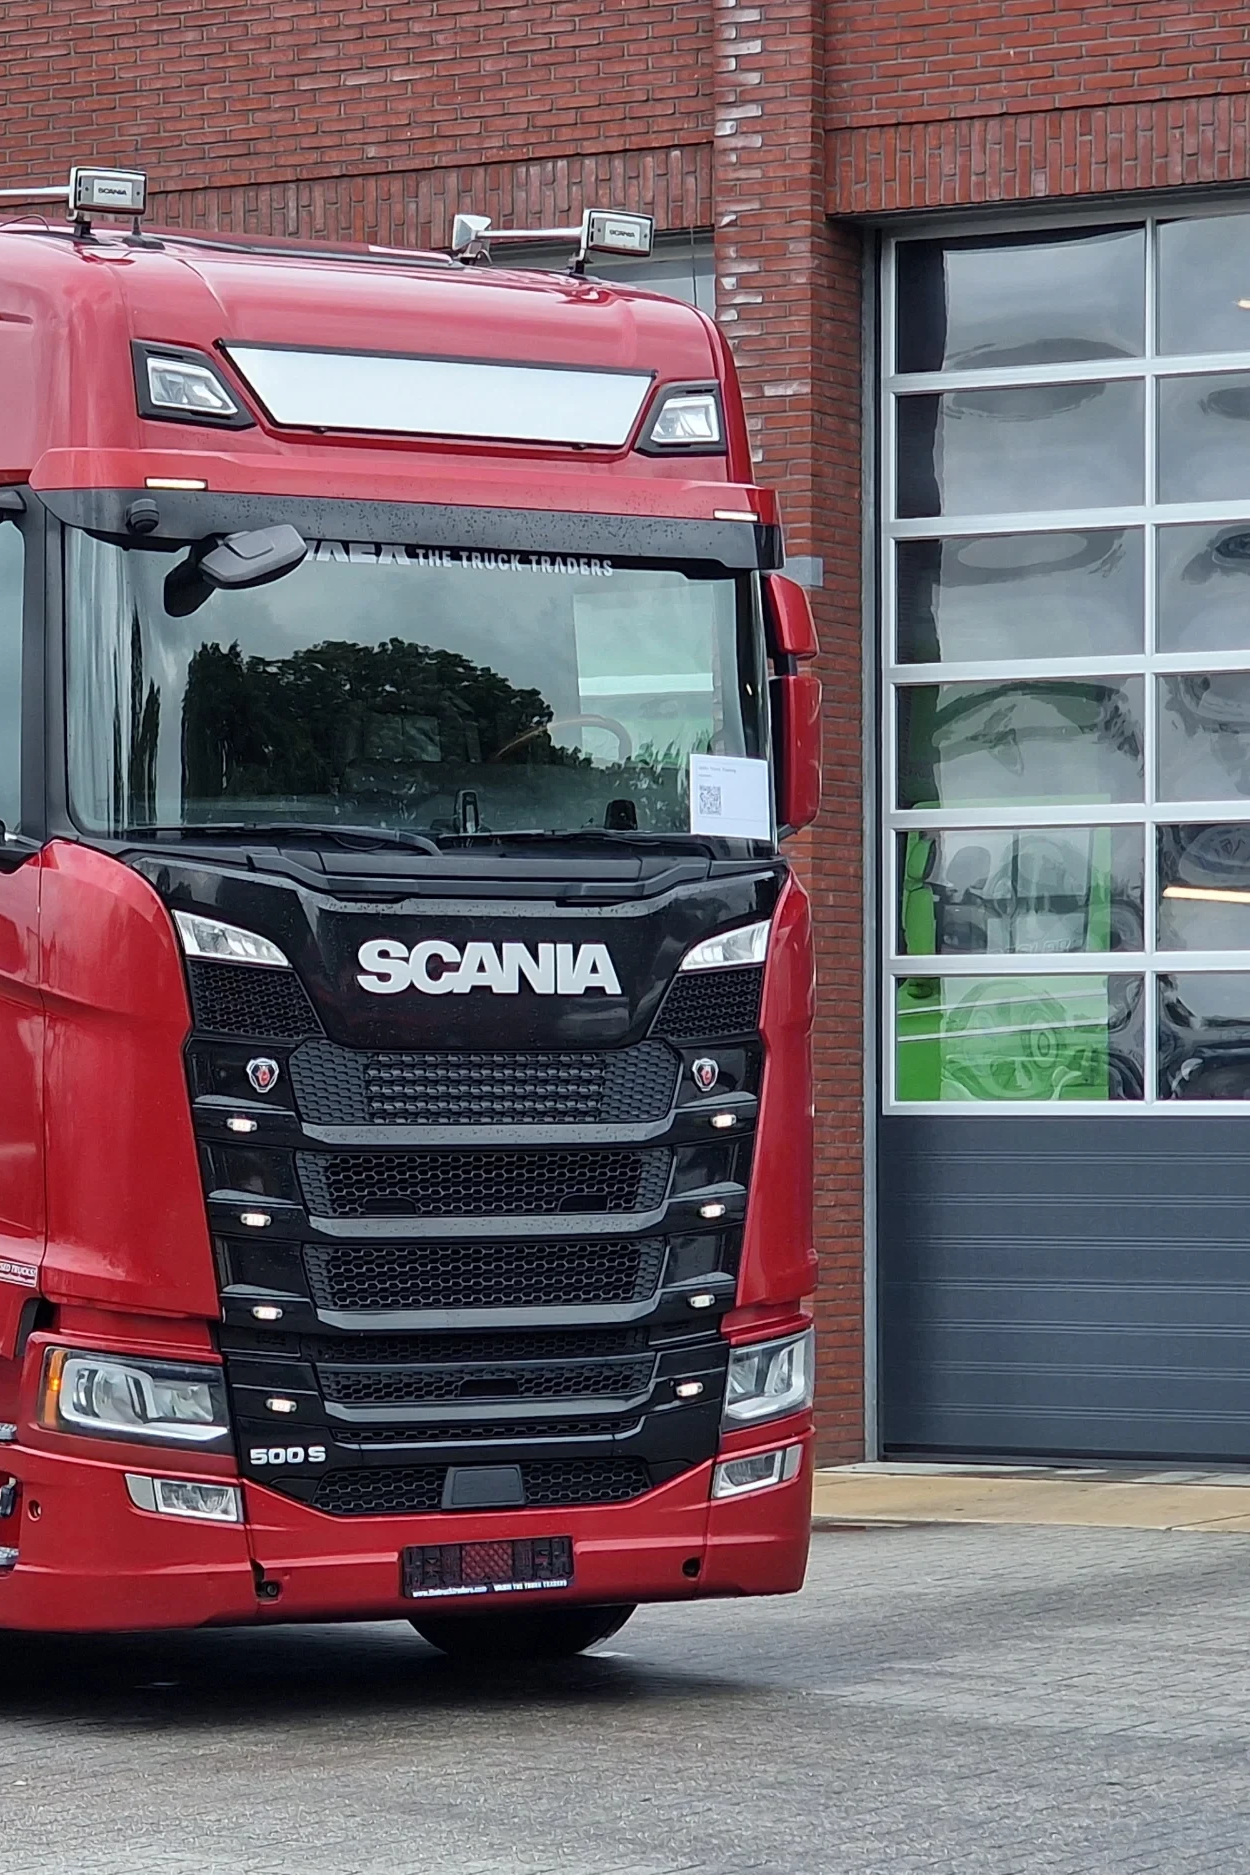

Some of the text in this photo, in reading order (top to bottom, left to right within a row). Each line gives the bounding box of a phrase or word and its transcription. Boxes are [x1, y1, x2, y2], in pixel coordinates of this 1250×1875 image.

[98, 187, 127, 196] SCANIA
[415, 548, 453, 568] THE
[459, 550, 523, 573] TRUCK
[529, 554, 614, 577] TRADERS
[356, 939, 623, 996] SCANIA
[250, 1445, 326, 1464] 500 S
